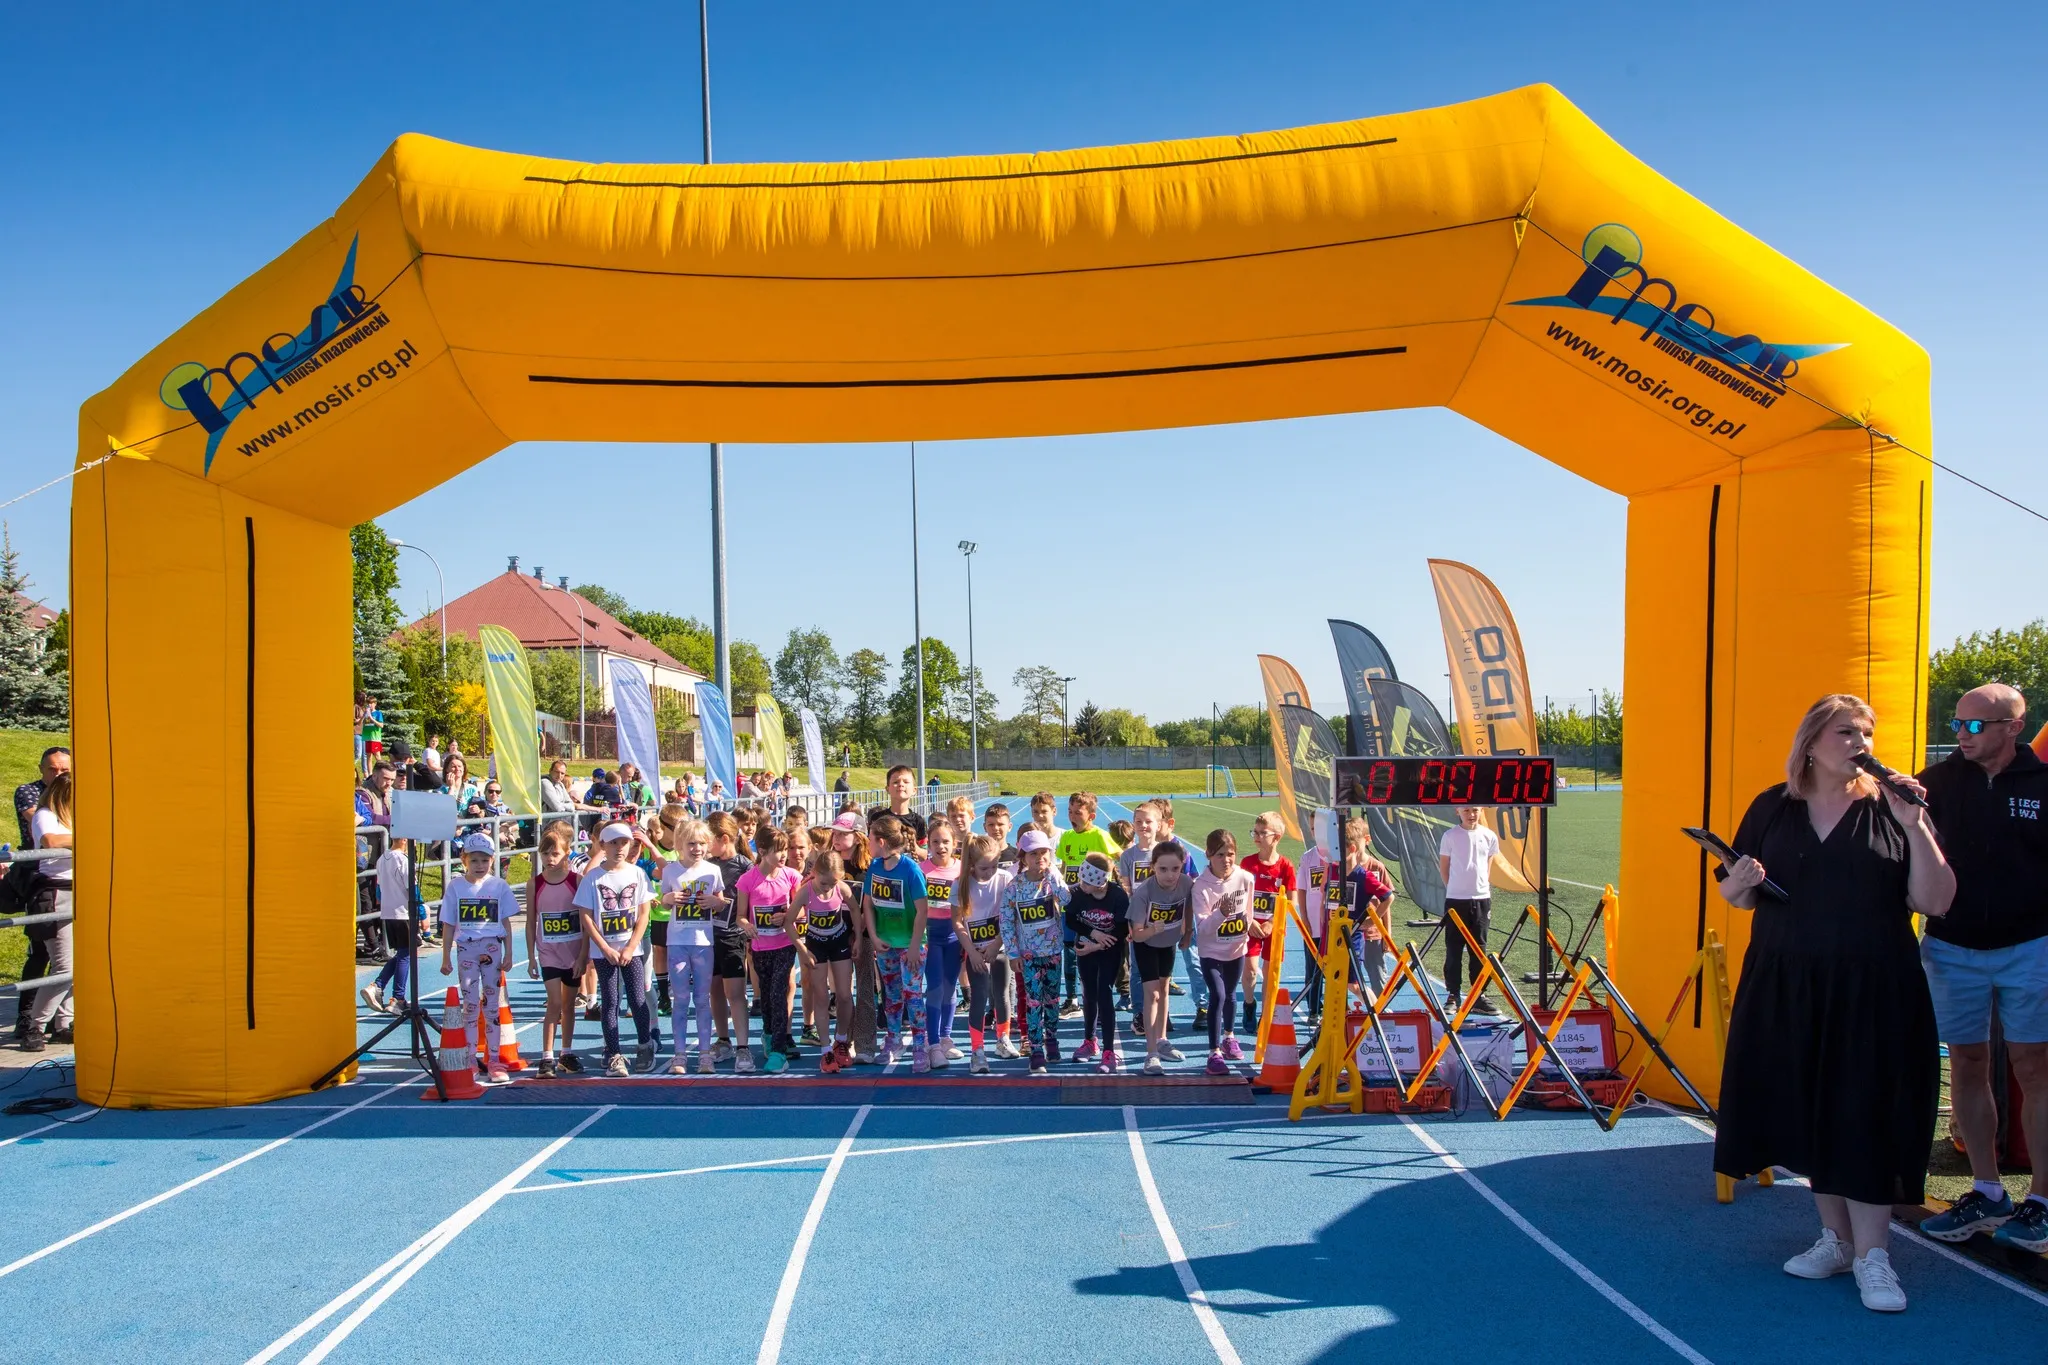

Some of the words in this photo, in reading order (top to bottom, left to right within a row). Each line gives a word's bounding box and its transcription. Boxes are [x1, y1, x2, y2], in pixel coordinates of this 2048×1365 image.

[320, 311, 391, 364] mazowiecki
[1546, 321, 1748, 440] www.mosir.org.pl
[1694, 357, 1778, 409] mazowiecki
[236, 339, 419, 458] www.mosir.org.pl
[1367, 761, 1396, 803] 0
[1493, 760, 1552, 803] 00
[1066, 872, 1080, 883] 73
[1135, 868, 1153, 880] 71
[872, 882, 891, 898] 710
[927, 884, 951, 899] 693
[677, 904, 701, 918] 712
[1254, 897, 1268, 910] 40
[460, 905, 488, 919] 714
[1020, 905, 1046, 920] 706
[1151, 909, 1177, 921] 697
[544, 918, 570, 933] 695
[603, 916, 628, 932] 711
[811, 915, 835, 927] 707
[1220, 919, 1244, 934] 700
[970, 924, 996, 940] 708
[1557, 1033, 1585, 1043] 11845
